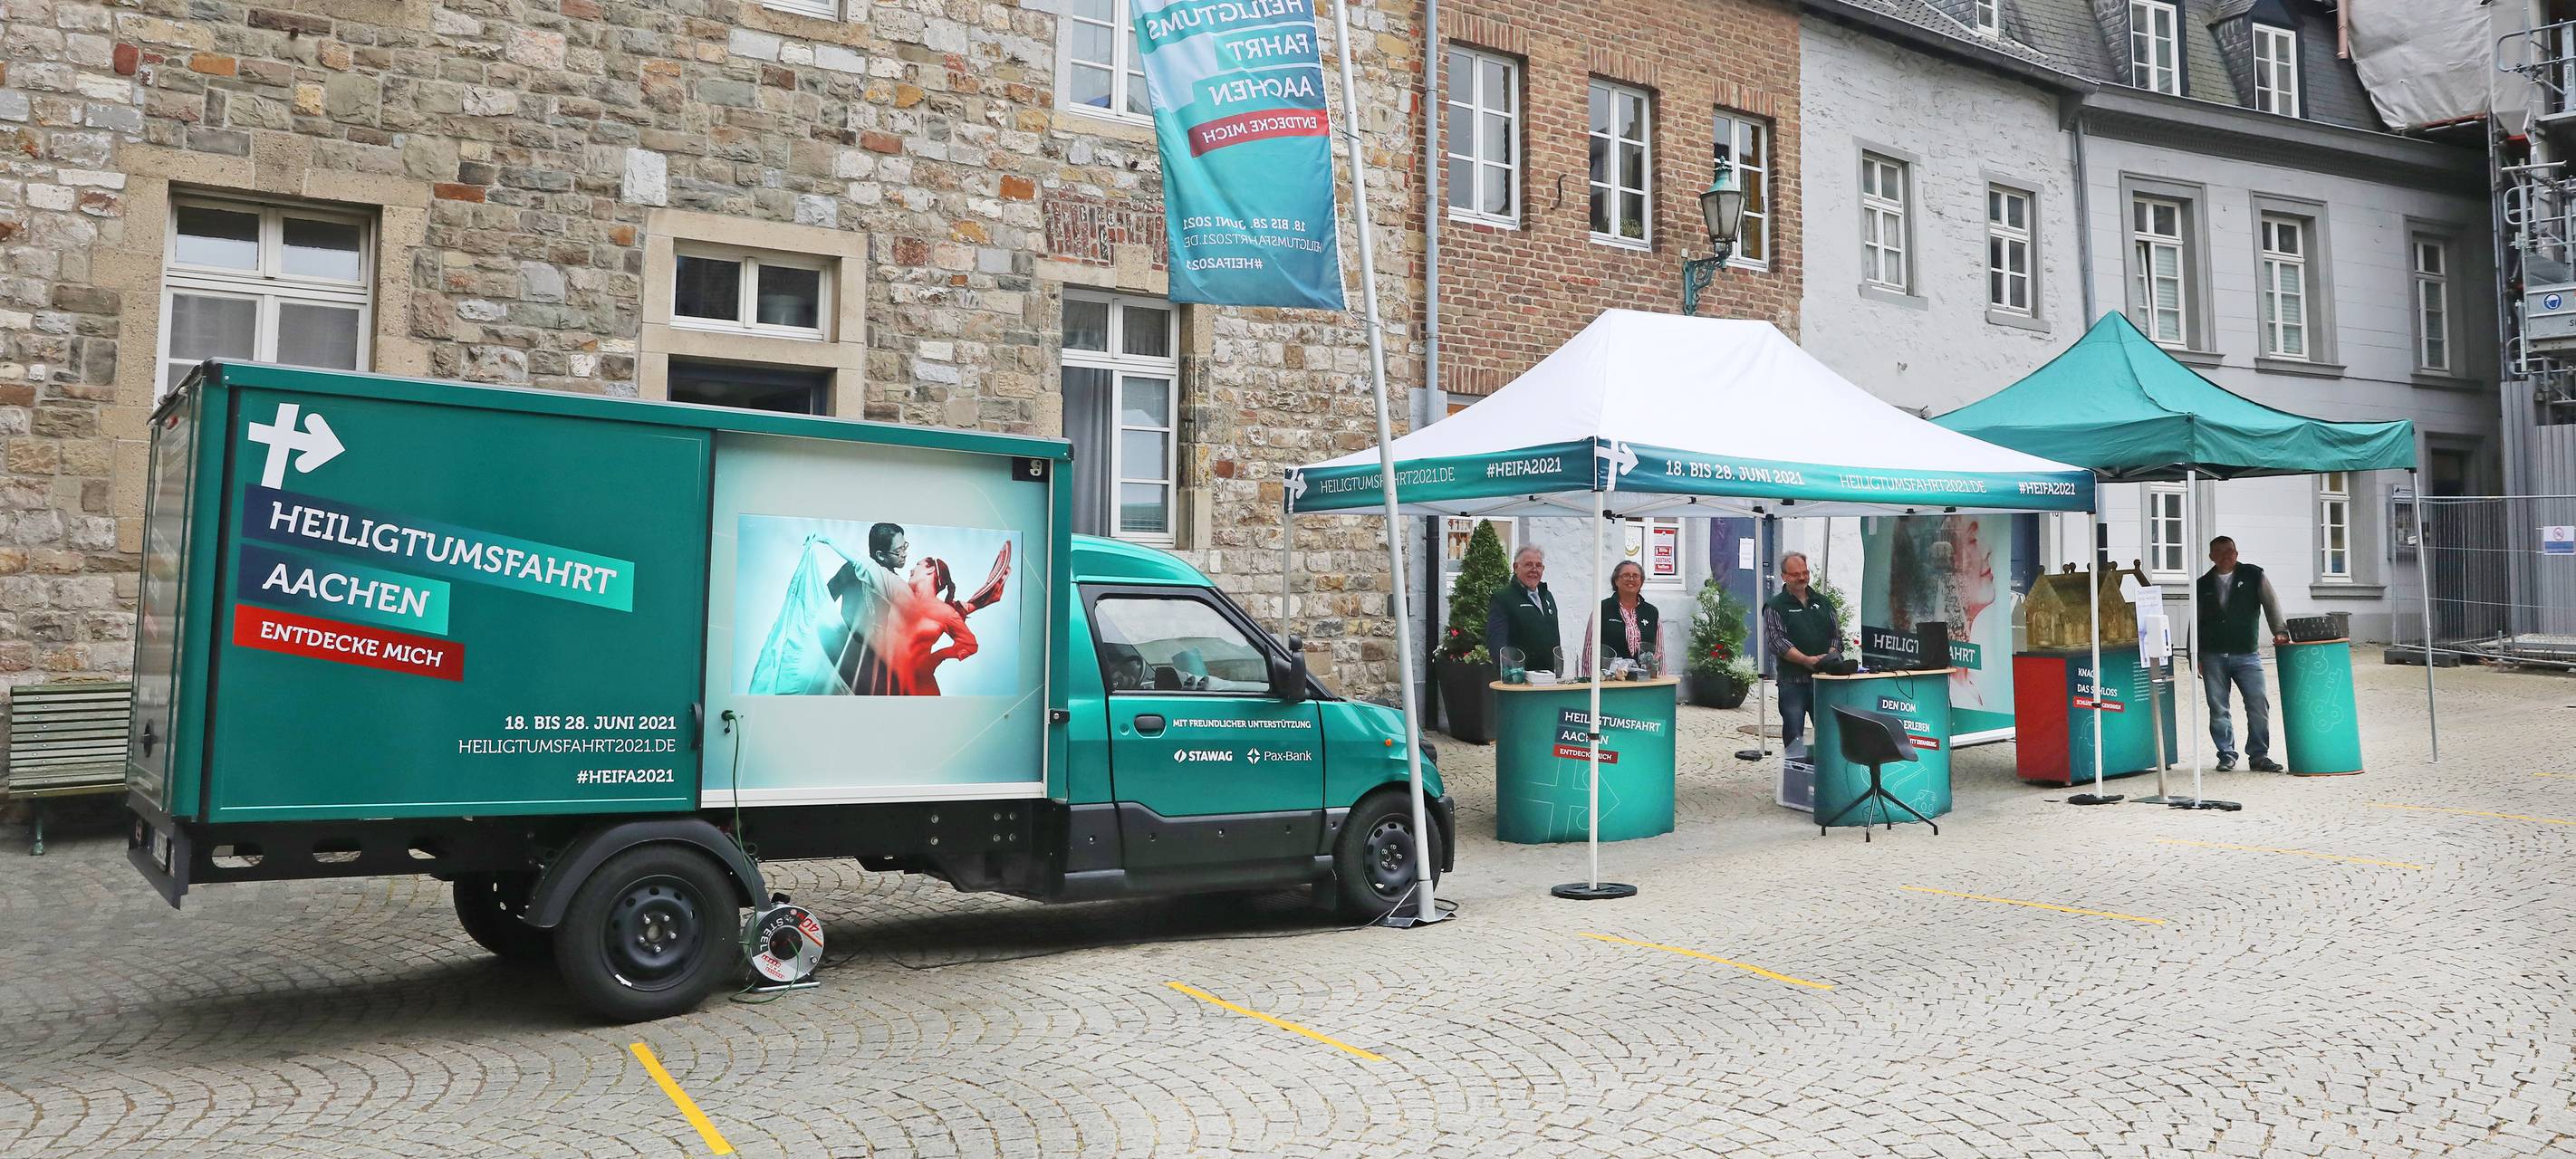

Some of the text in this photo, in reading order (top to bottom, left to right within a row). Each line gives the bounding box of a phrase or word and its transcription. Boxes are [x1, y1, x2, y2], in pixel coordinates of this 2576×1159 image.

[1320, 457, 1562, 493] HEILIGTUMSFHRT2021.DE #HEIFA2021
[1666, 460, 2076, 496] 18. BIS 28. JUNI 2021 HEILIGTUMSFAHRT2021.DE #HEIFA2021
[269, 501, 618, 595] HEILIGTUMSFAHRT
[262, 562, 430, 618] AACHEN
[260, 621, 443, 667] ENTDECKE MICH
[2077, 684, 2090, 694] DAS
[1882, 699, 1917, 713] DEN DOM
[505, 716, 677, 731] 18. BIS 28. JUNI 2021
[1173, 719, 1312, 729] MIT FREUNDLICHER UNTERSTÜTZUNG
[1903, 720, 1930, 733] ERLEBEN
[458, 739, 677, 754] HEILIGTUMSFAHRT2021.DE
[1560, 748, 1591, 758] ENTDECK
[1188, 751, 1233, 762] STAWAG
[1264, 751, 1312, 761] Pax-Bank
[576, 770, 675, 784] #HEIFA2021
